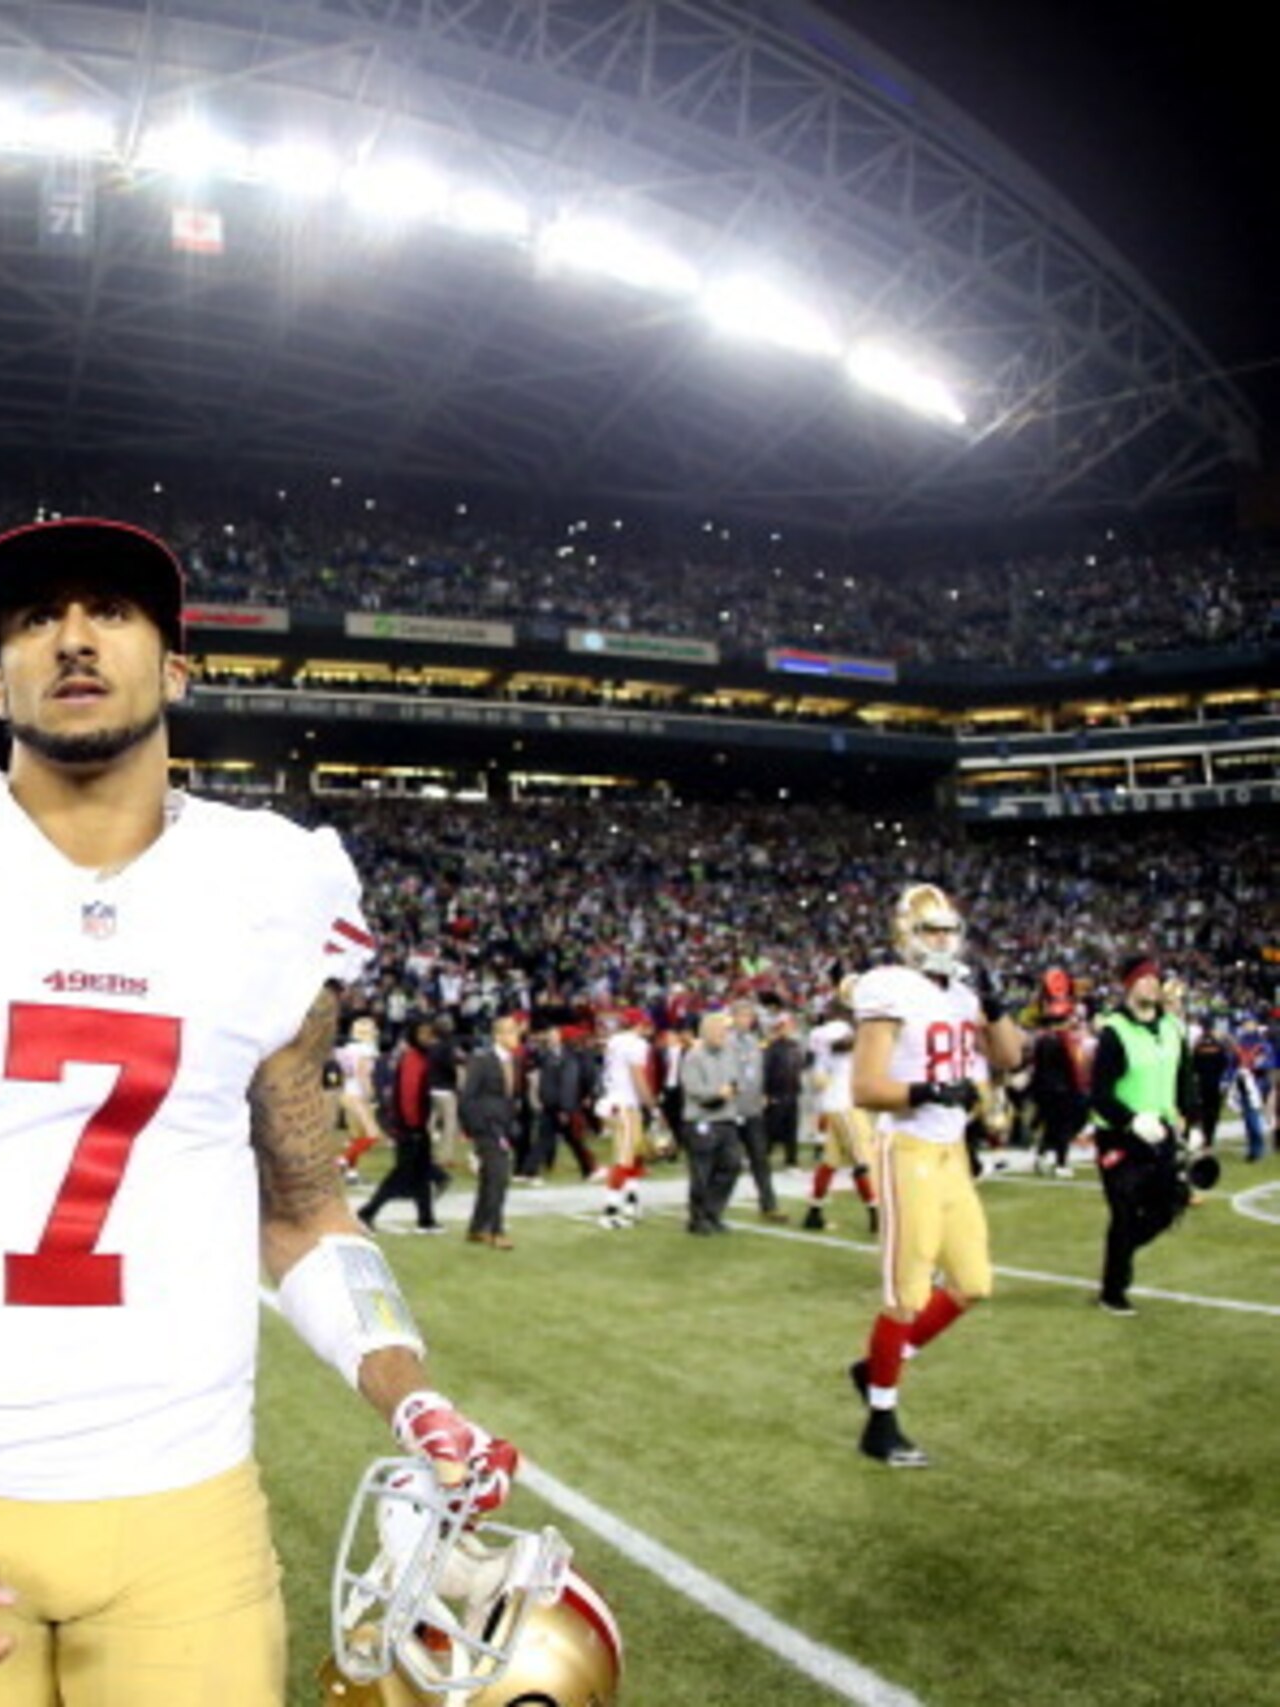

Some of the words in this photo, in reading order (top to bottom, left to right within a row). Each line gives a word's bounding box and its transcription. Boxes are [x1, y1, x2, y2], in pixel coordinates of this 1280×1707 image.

[49, 206, 84, 234] 71
[43, 967, 148, 996] 49ERS
[5, 1001, 183, 1307] 7
